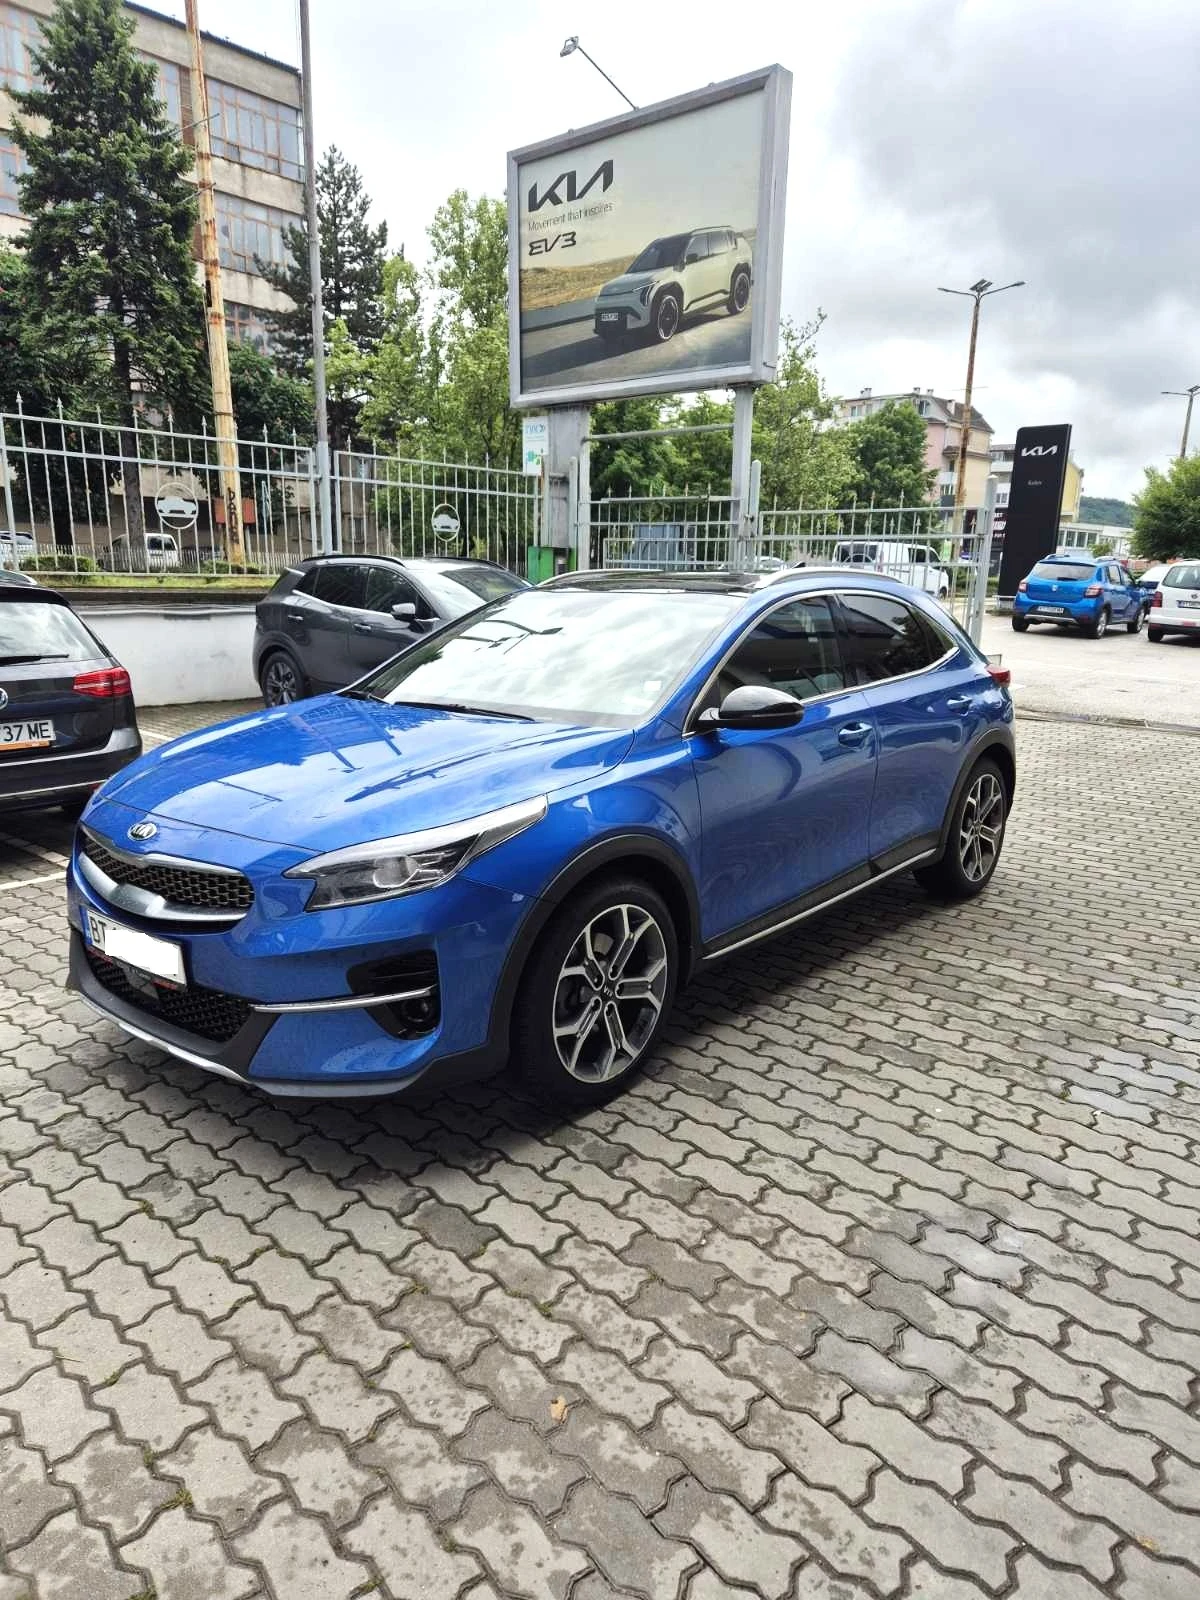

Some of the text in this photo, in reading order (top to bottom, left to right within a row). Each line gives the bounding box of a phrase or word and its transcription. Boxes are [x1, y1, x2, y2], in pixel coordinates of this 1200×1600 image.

[528, 159, 614, 213] KIA
[528, 202, 613, 232] Movement that inspires
[528, 231, 577, 257] EV3
[1021, 445, 1058, 457] KIA
[0, 722, 51, 743] 37 ME
